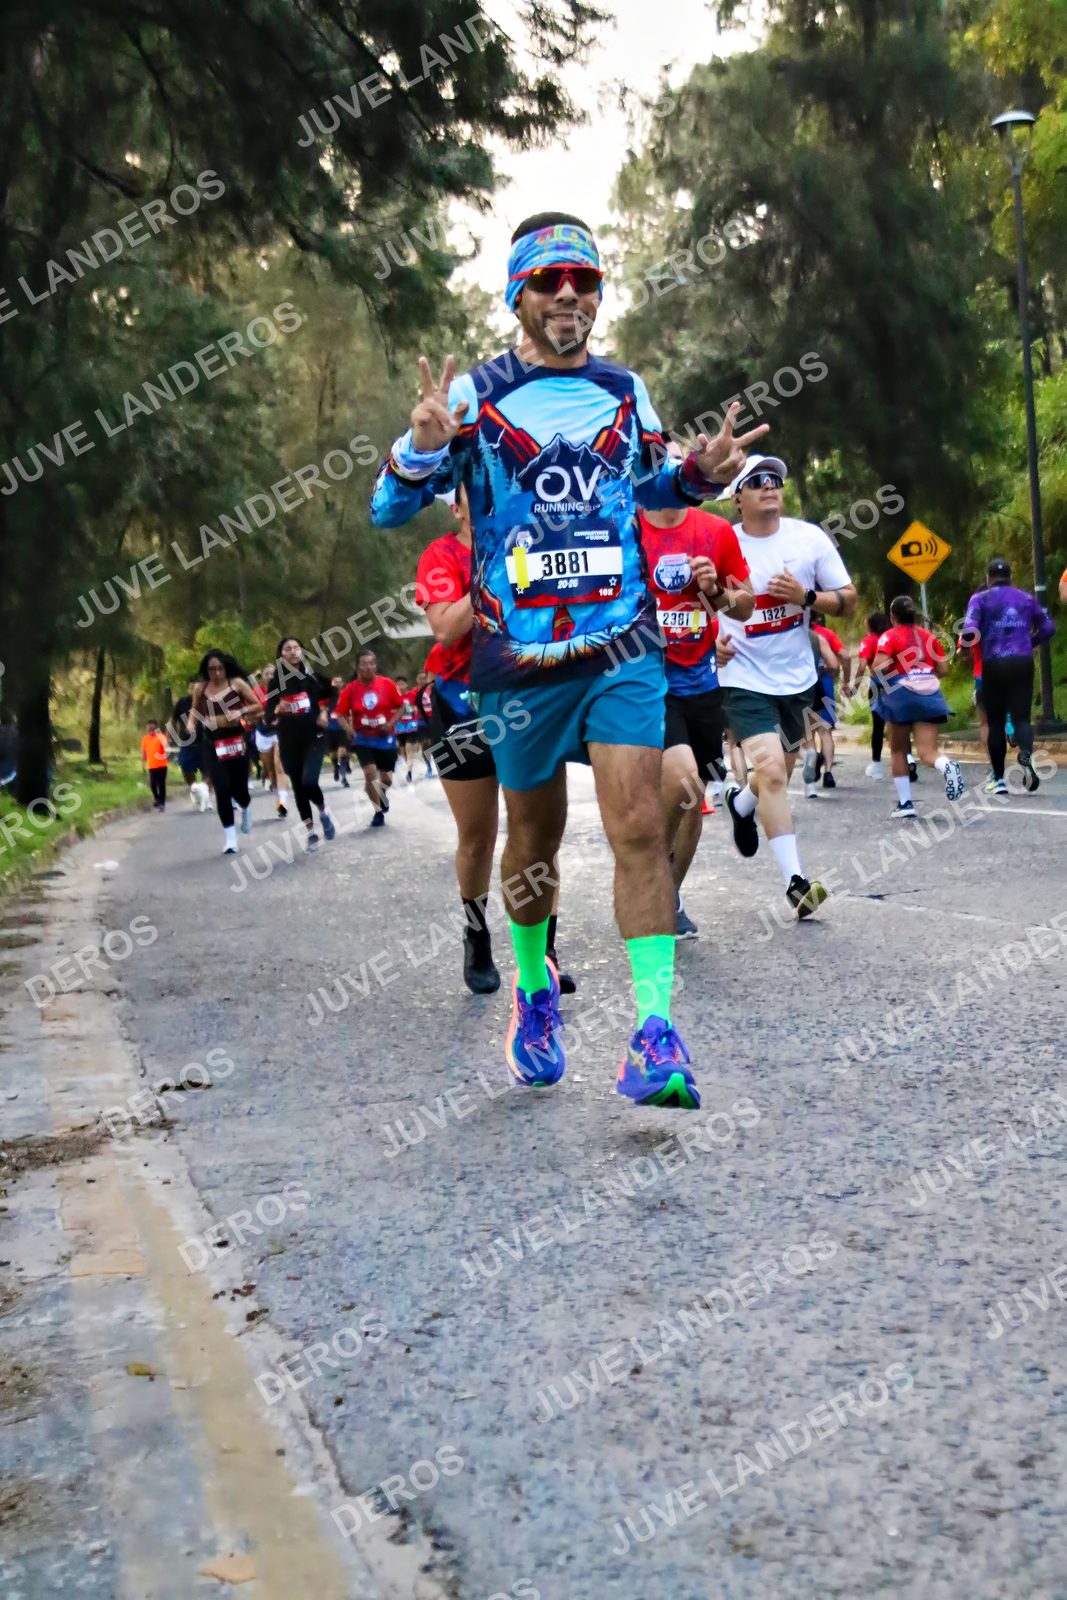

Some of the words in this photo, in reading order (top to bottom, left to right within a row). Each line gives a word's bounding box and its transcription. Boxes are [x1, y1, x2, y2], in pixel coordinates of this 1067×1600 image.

[535, 464, 603, 503] OV
[534, 502, 585, 513] RUNNING
[541, 551, 589, 577] 3881
[663, 612, 690, 626] 2381
[762, 606, 787, 621] 1322
